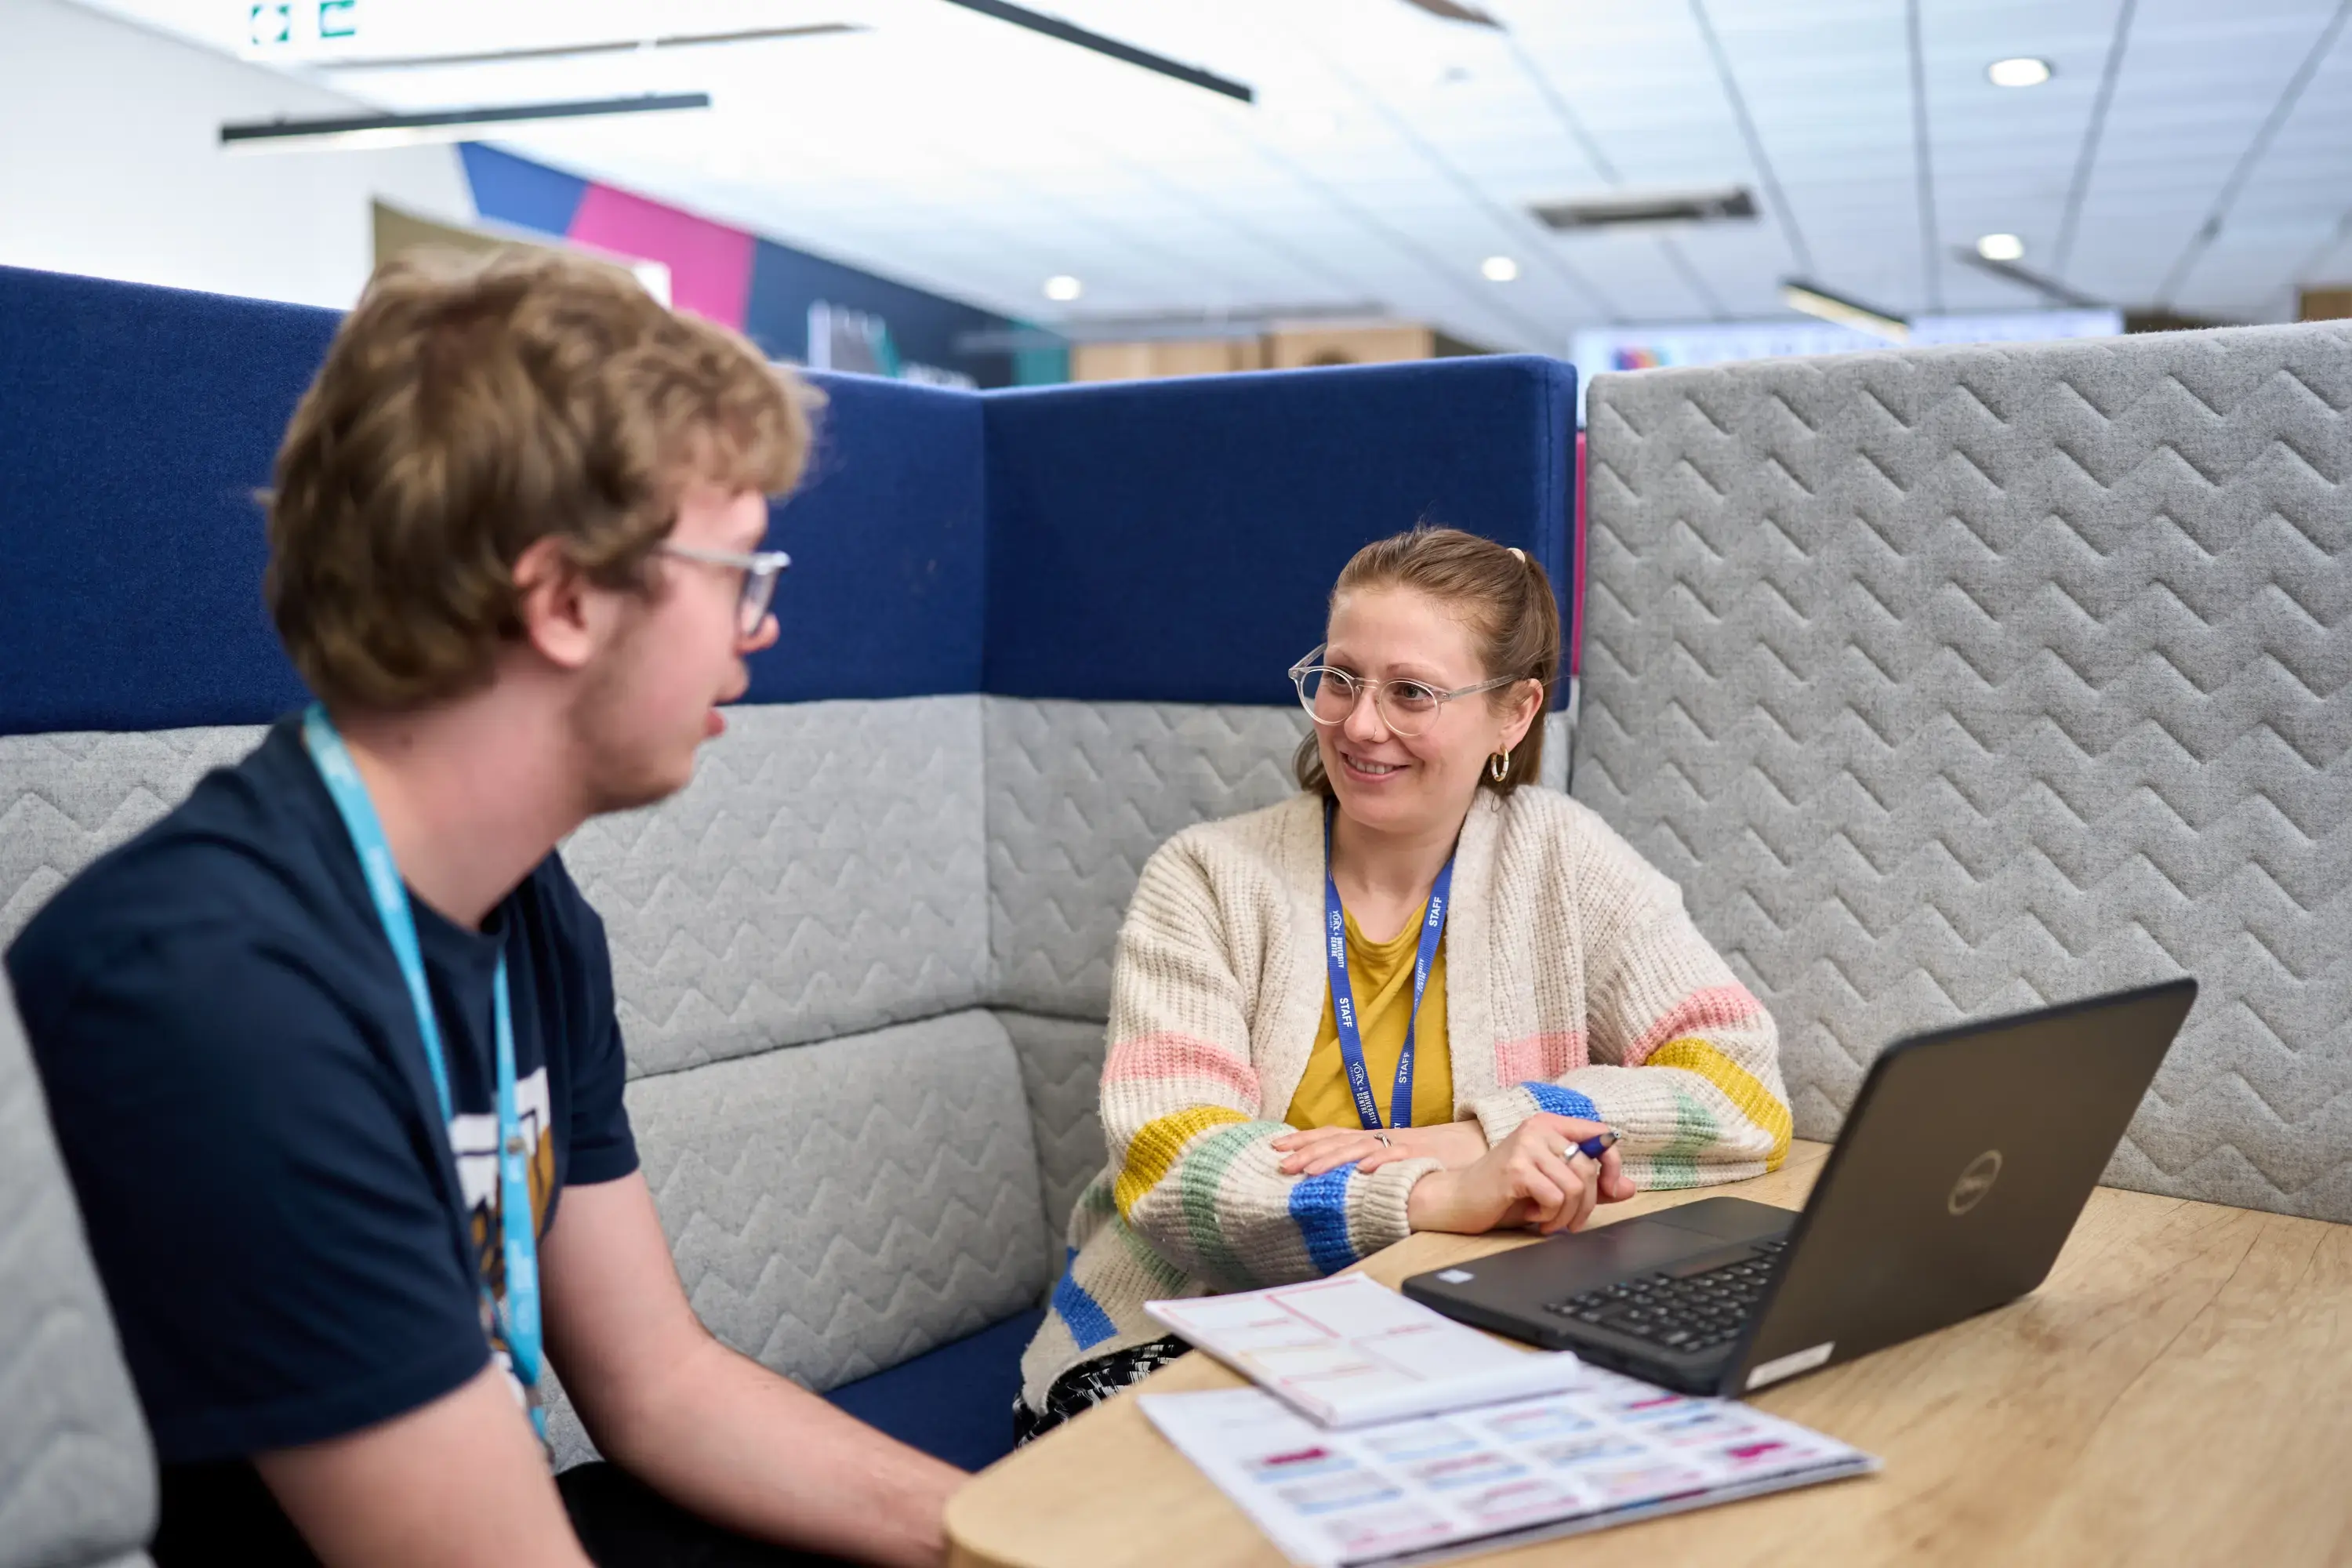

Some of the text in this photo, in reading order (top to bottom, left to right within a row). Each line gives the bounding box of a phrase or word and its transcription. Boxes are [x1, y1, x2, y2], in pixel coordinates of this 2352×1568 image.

[1333, 910, 1342, 931] YORK
[1429, 896, 1442, 927] STAFF
[1339, 997, 1352, 1028] STAFF
[1352, 1061, 1364, 1087] YORK
[1399, 1052, 1410, 1083] STAFF
[1356, 1092, 1368, 1114] CENTRE
[1363, 1091, 1378, 1124] UNIVERSITY
